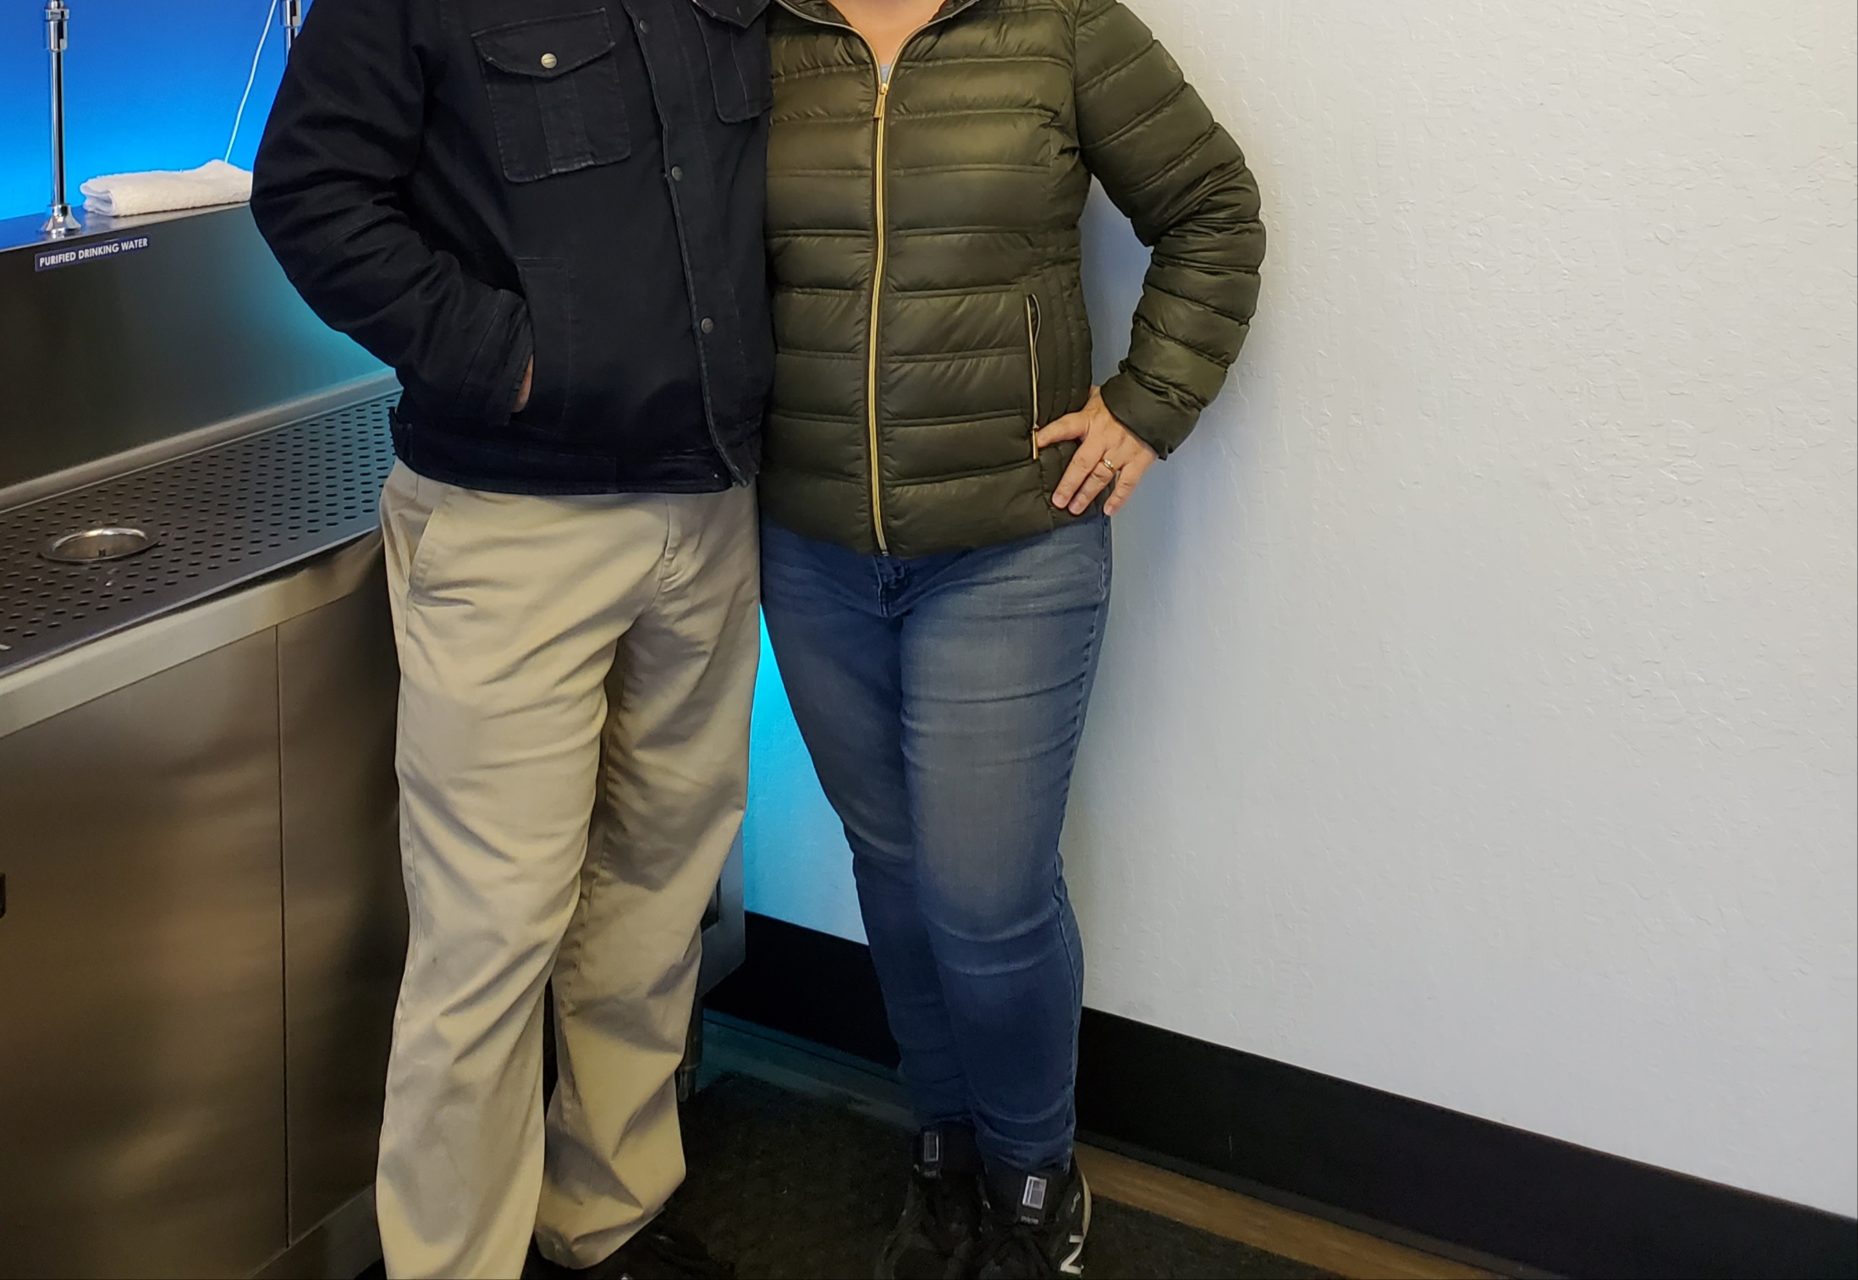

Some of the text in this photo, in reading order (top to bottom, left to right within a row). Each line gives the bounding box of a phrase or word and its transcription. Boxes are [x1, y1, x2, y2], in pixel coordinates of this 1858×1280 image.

[39, 238, 148, 267] PURIFIED DRINKING WATER
